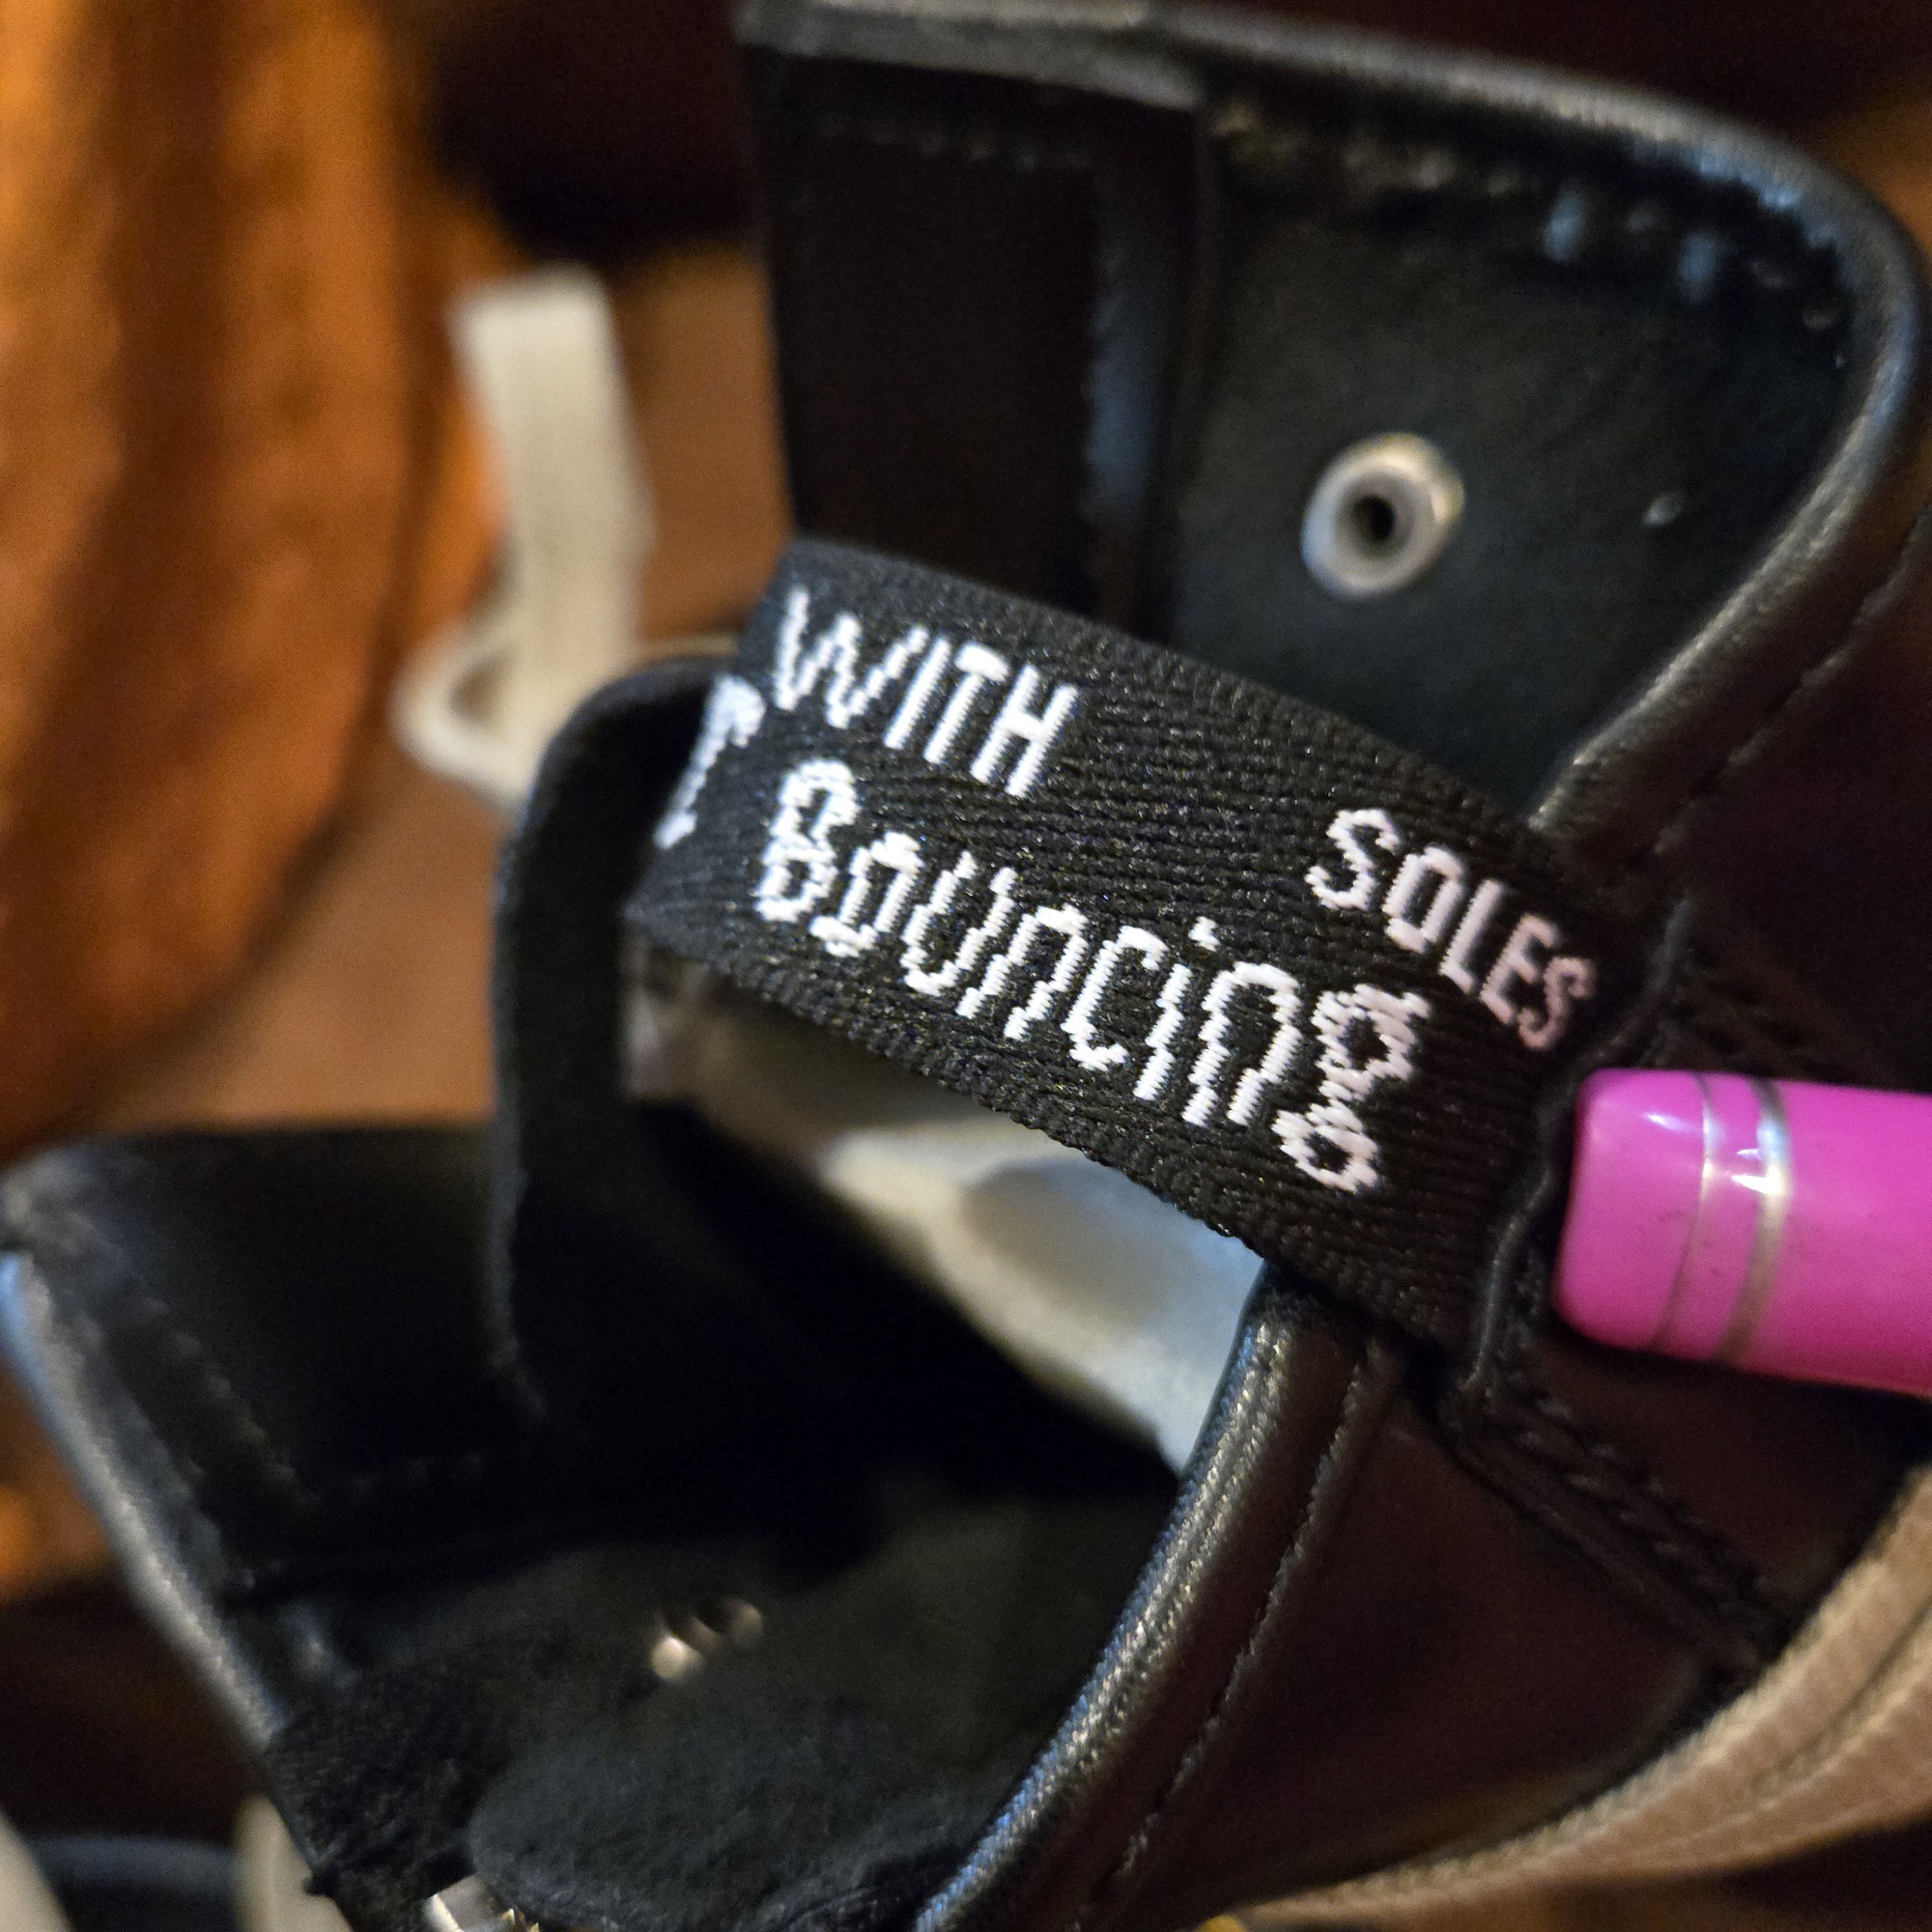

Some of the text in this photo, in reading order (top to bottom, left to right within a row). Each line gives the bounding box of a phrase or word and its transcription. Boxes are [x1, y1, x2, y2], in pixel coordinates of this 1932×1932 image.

[768, 584, 1082, 803] WITH
[749, 755, 1431, 1195] Bouncing
[1303, 808, 1601, 1051] SOLES
